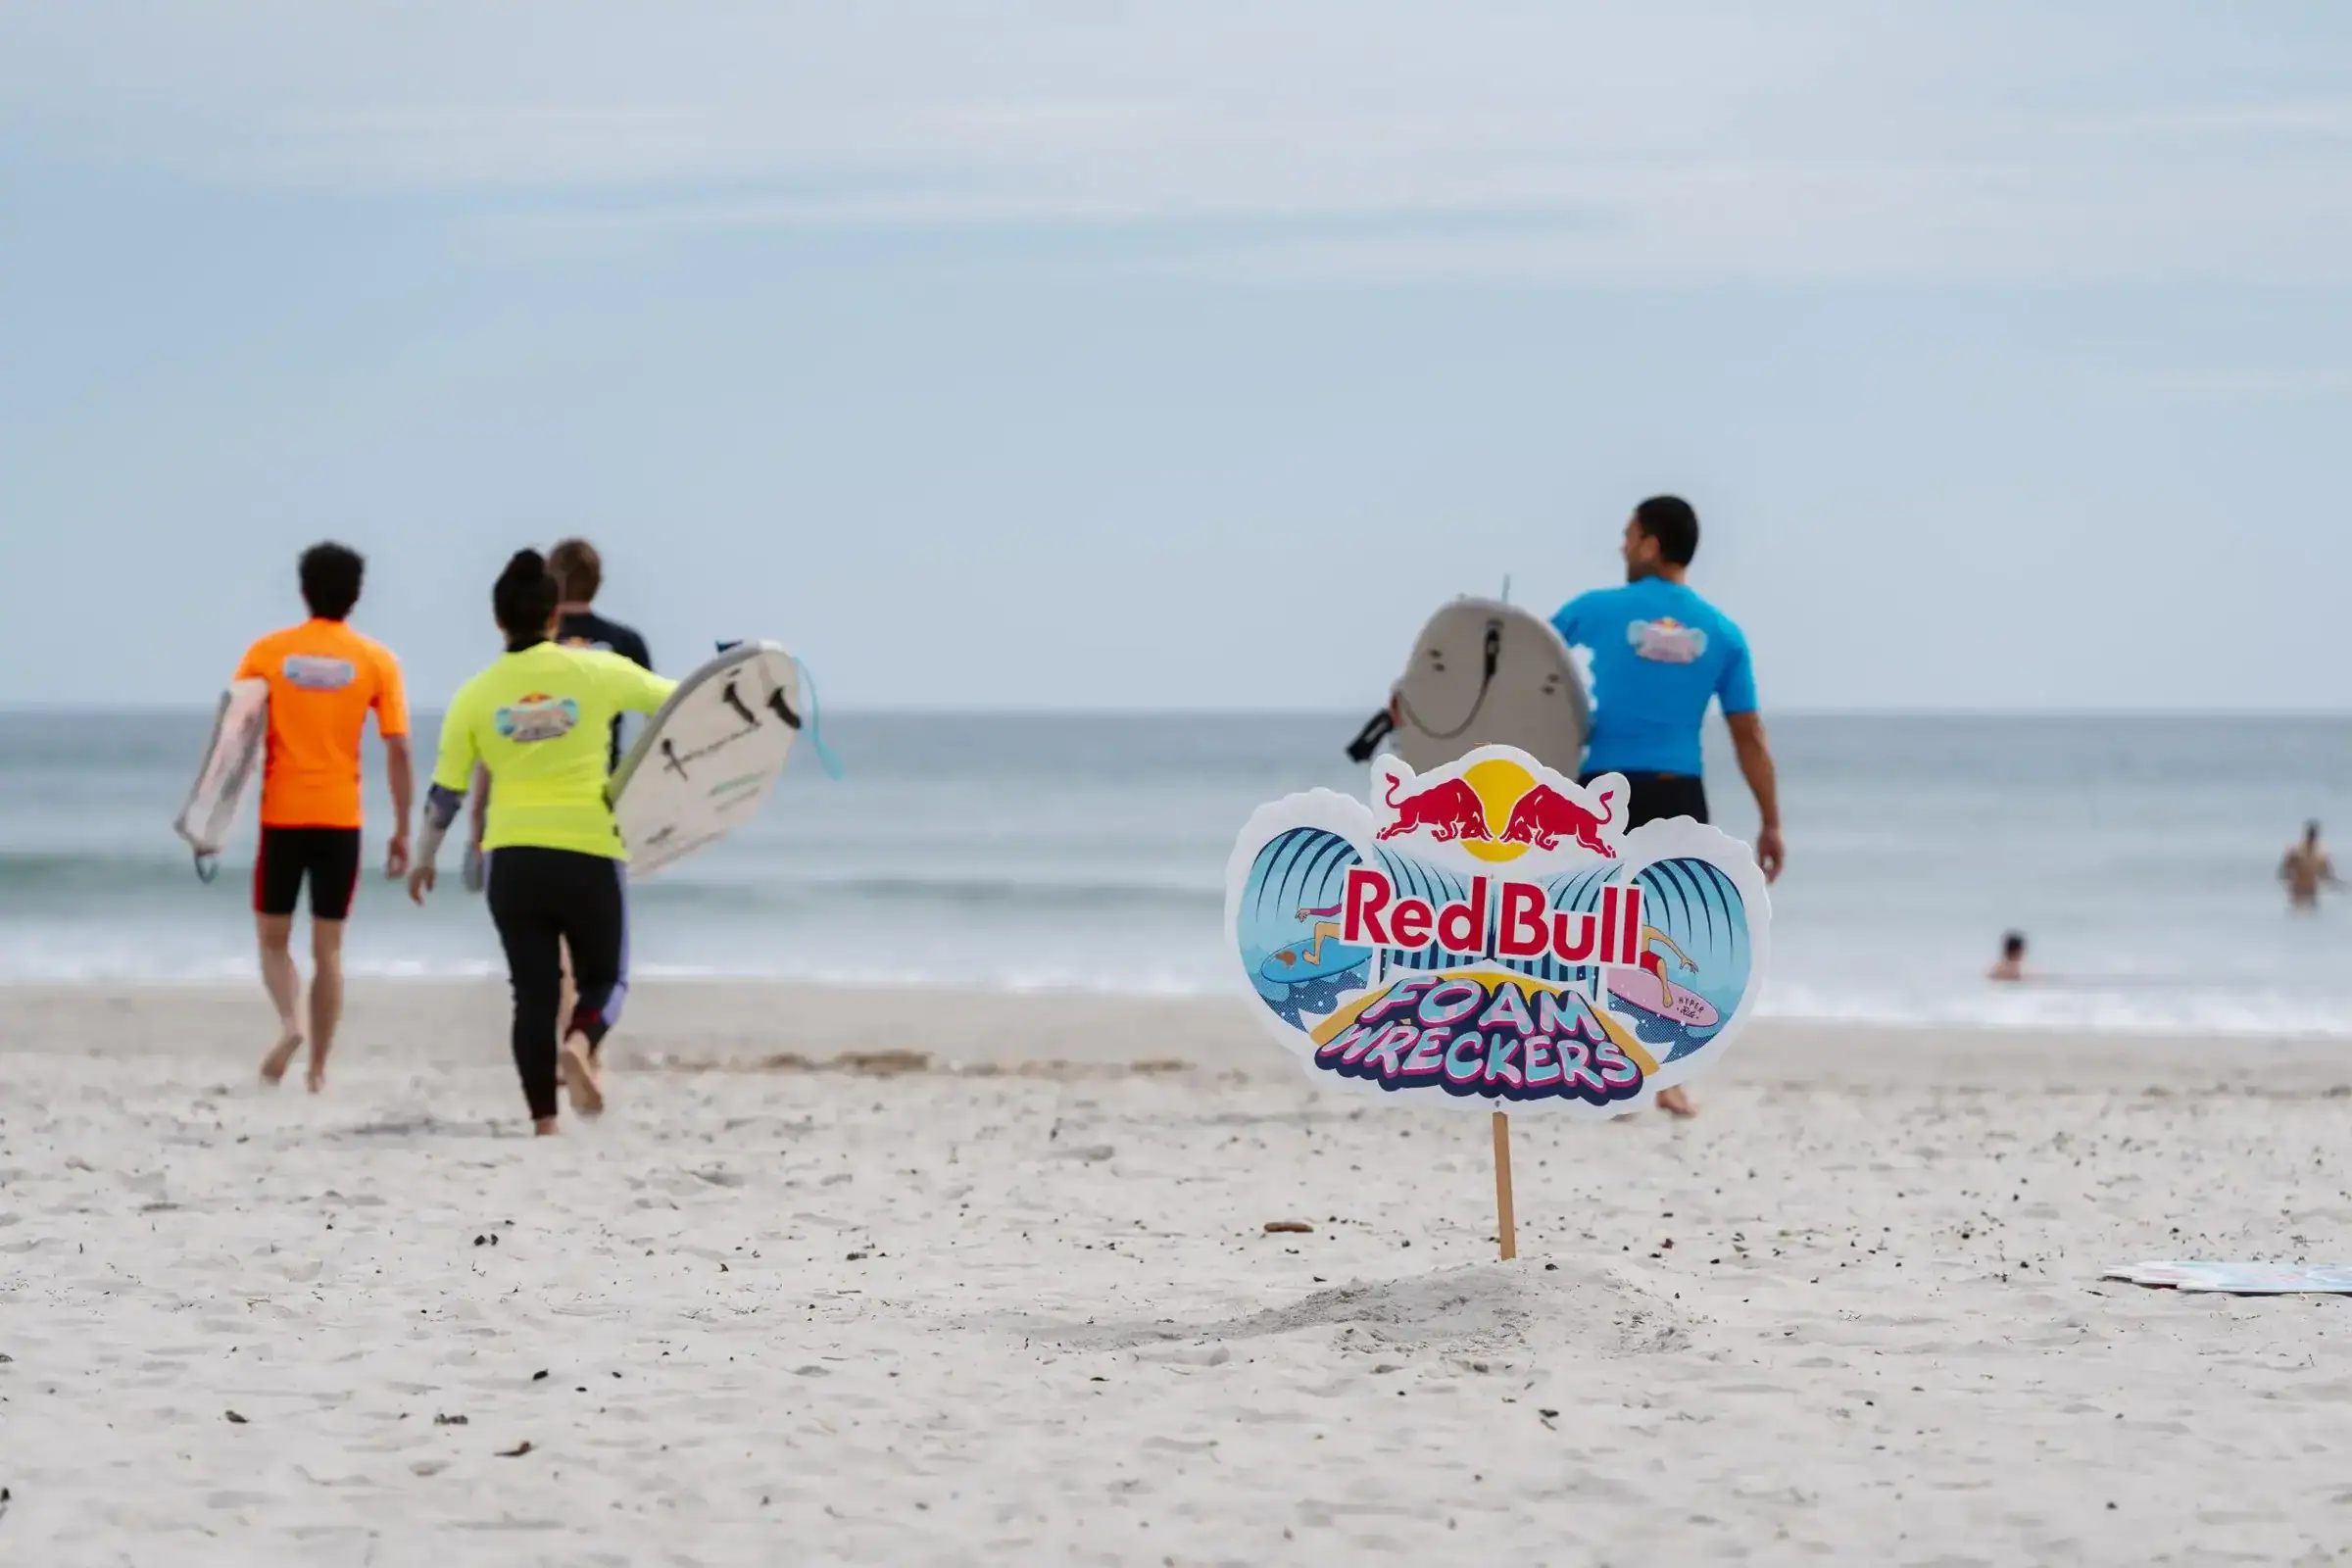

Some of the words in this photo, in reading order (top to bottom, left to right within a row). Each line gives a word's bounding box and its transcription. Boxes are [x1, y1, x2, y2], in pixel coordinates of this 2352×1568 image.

[1345, 869, 1487, 952] Red
[1499, 882, 1641, 964] Bull
[1359, 976, 1608, 1042] FOAM
[1319, 1019, 1640, 1093] WRECKERS
